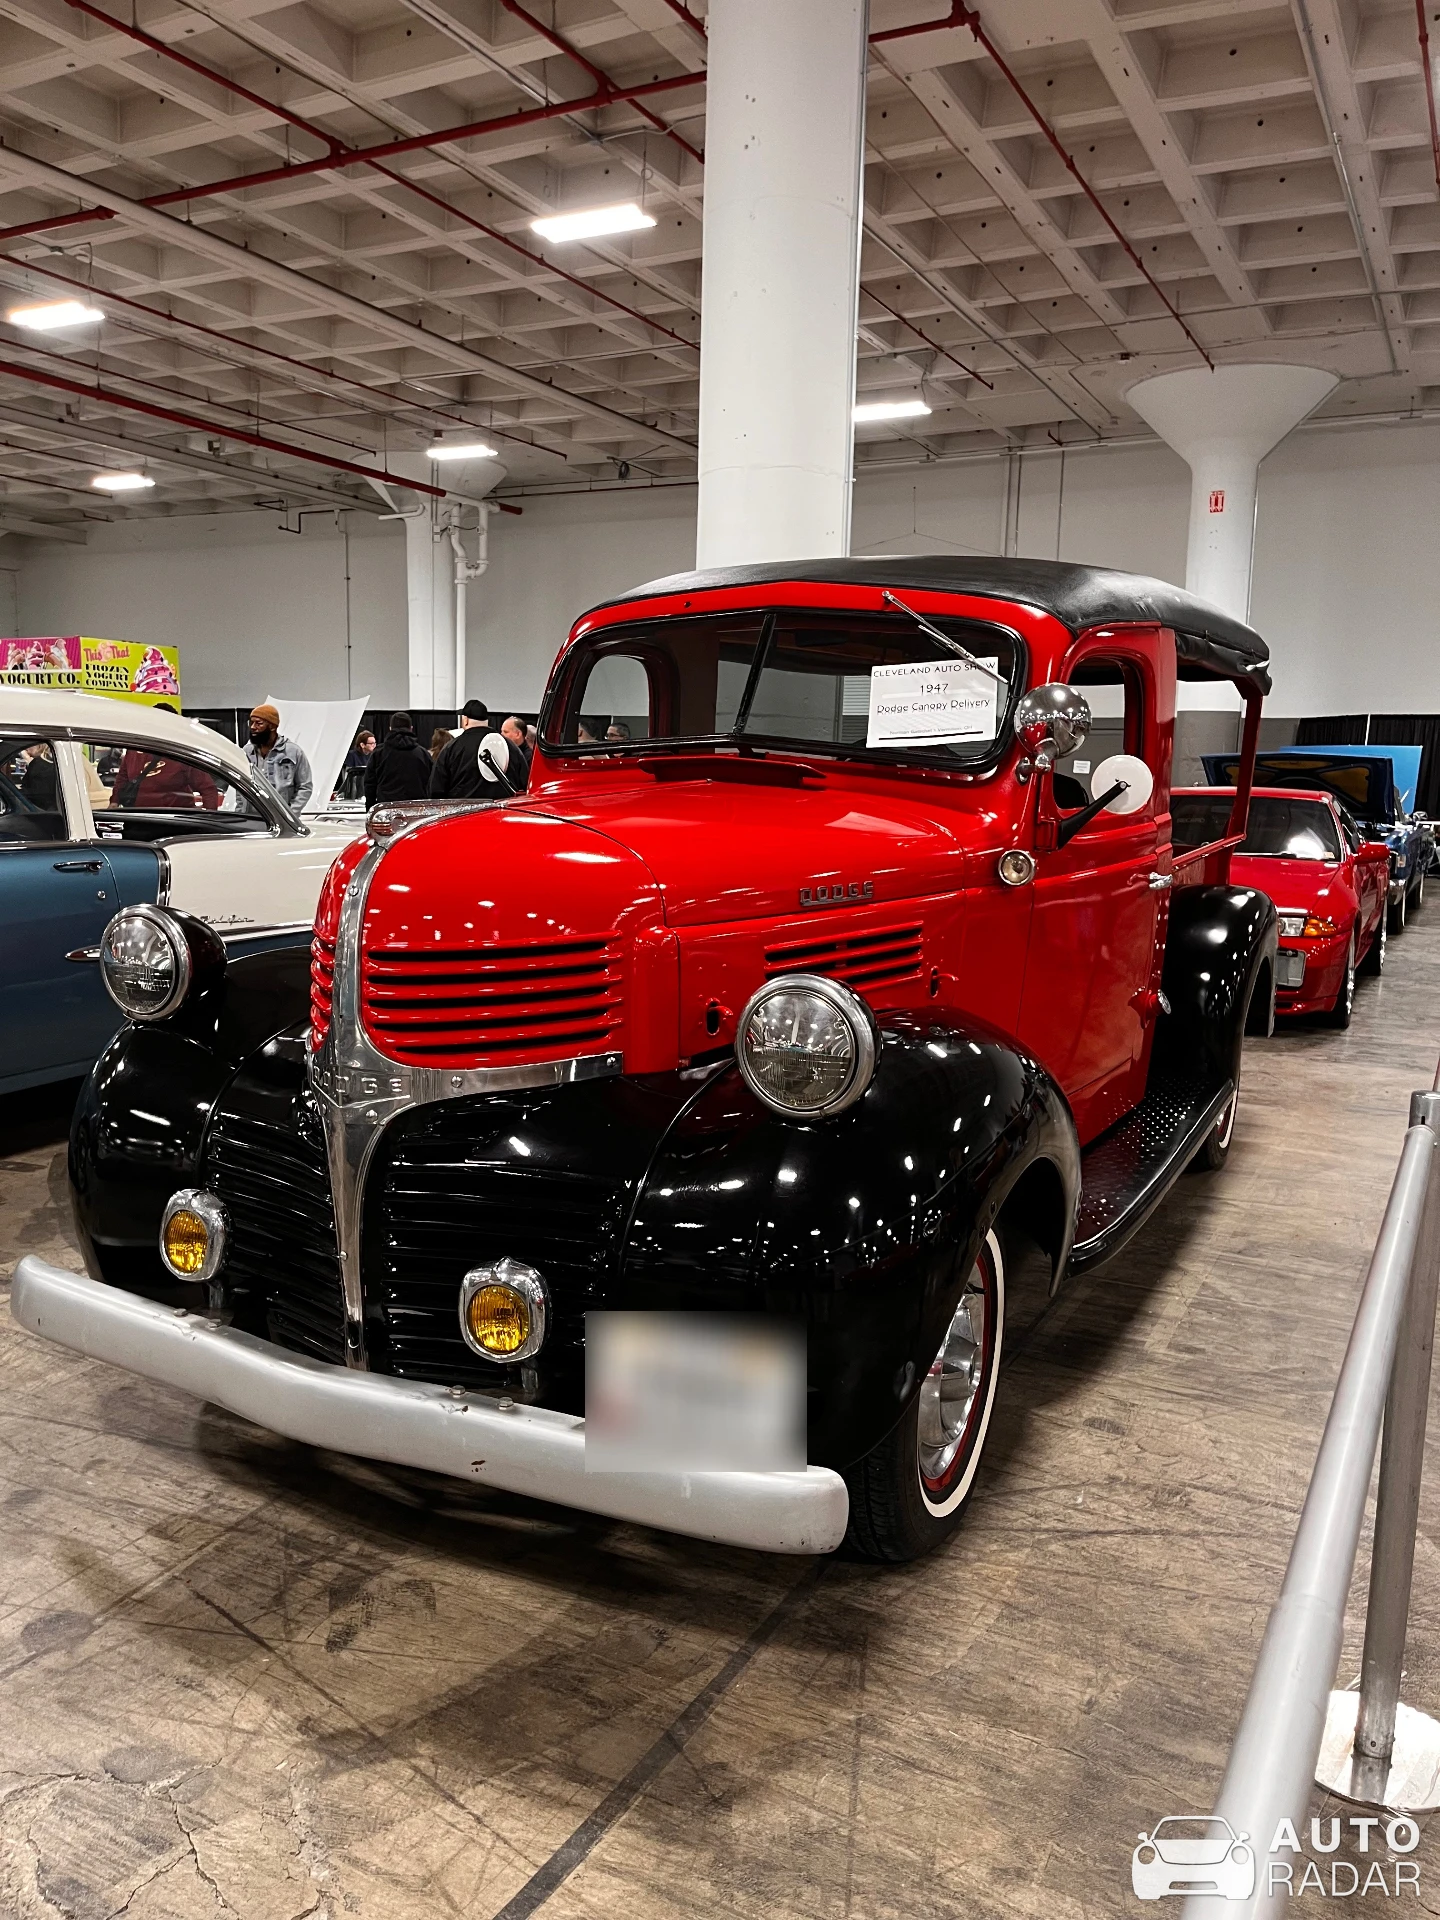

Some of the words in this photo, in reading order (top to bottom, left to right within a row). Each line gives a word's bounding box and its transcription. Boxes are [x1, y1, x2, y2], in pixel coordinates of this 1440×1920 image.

[83, 648, 103, 662] This
[110, 645, 130, 659] That
[85, 663, 129, 673] FROZEN
[873, 666, 931, 678] CLEVELAND
[934, 664, 962, 673] AUTO
[964, 661, 996, 672] SHW
[57, 674, 81, 685] CO.
[85, 672, 129, 681] YOGURT
[85, 679, 129, 689] COMPANY
[919, 683, 949, 695] 1947
[877, 704, 909, 715] Dodge
[911, 701, 948, 714] Canopy
[950, 698, 991, 710] Delivery
[800, 881, 873, 906] DODGE
